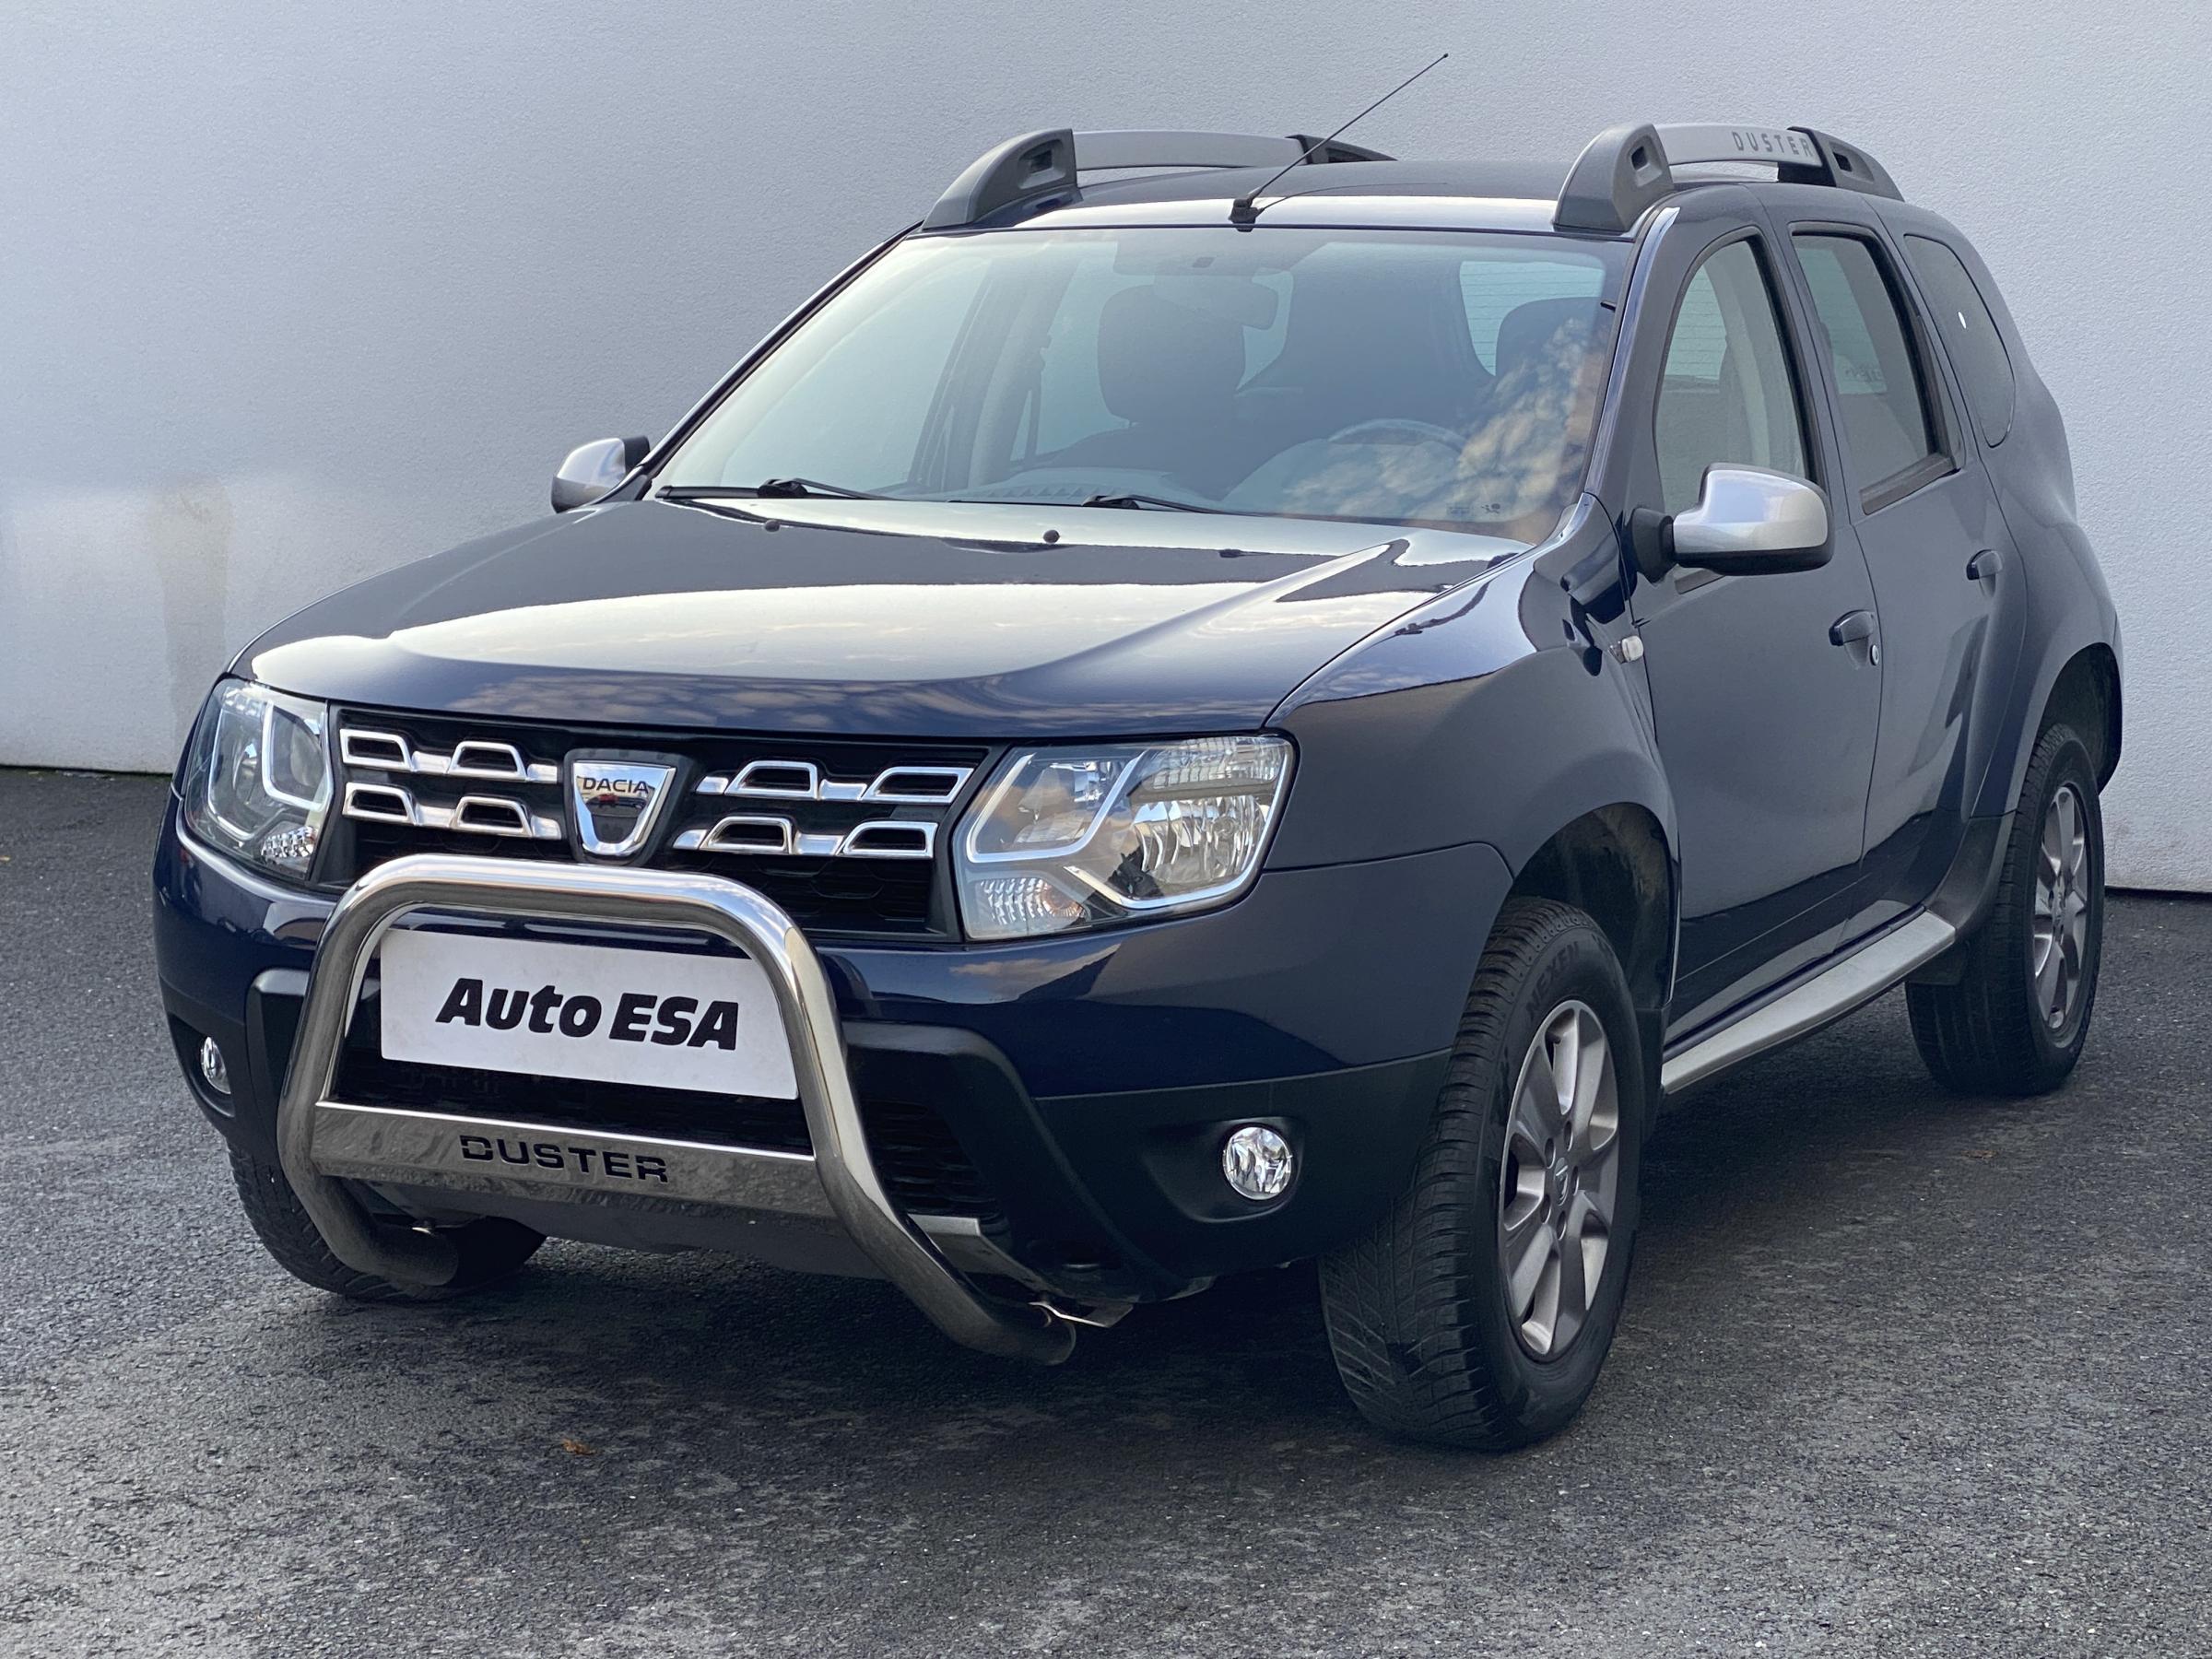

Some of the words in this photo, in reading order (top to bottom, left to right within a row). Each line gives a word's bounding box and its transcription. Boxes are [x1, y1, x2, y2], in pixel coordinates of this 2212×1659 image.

[1732, 131, 1814, 157] DUSTER
[582, 777, 649, 794] DACIA
[435, 978, 602, 1038] Auto
[608, 993, 739, 1051] ESA
[459, 1135, 669, 1183] DUSTER
